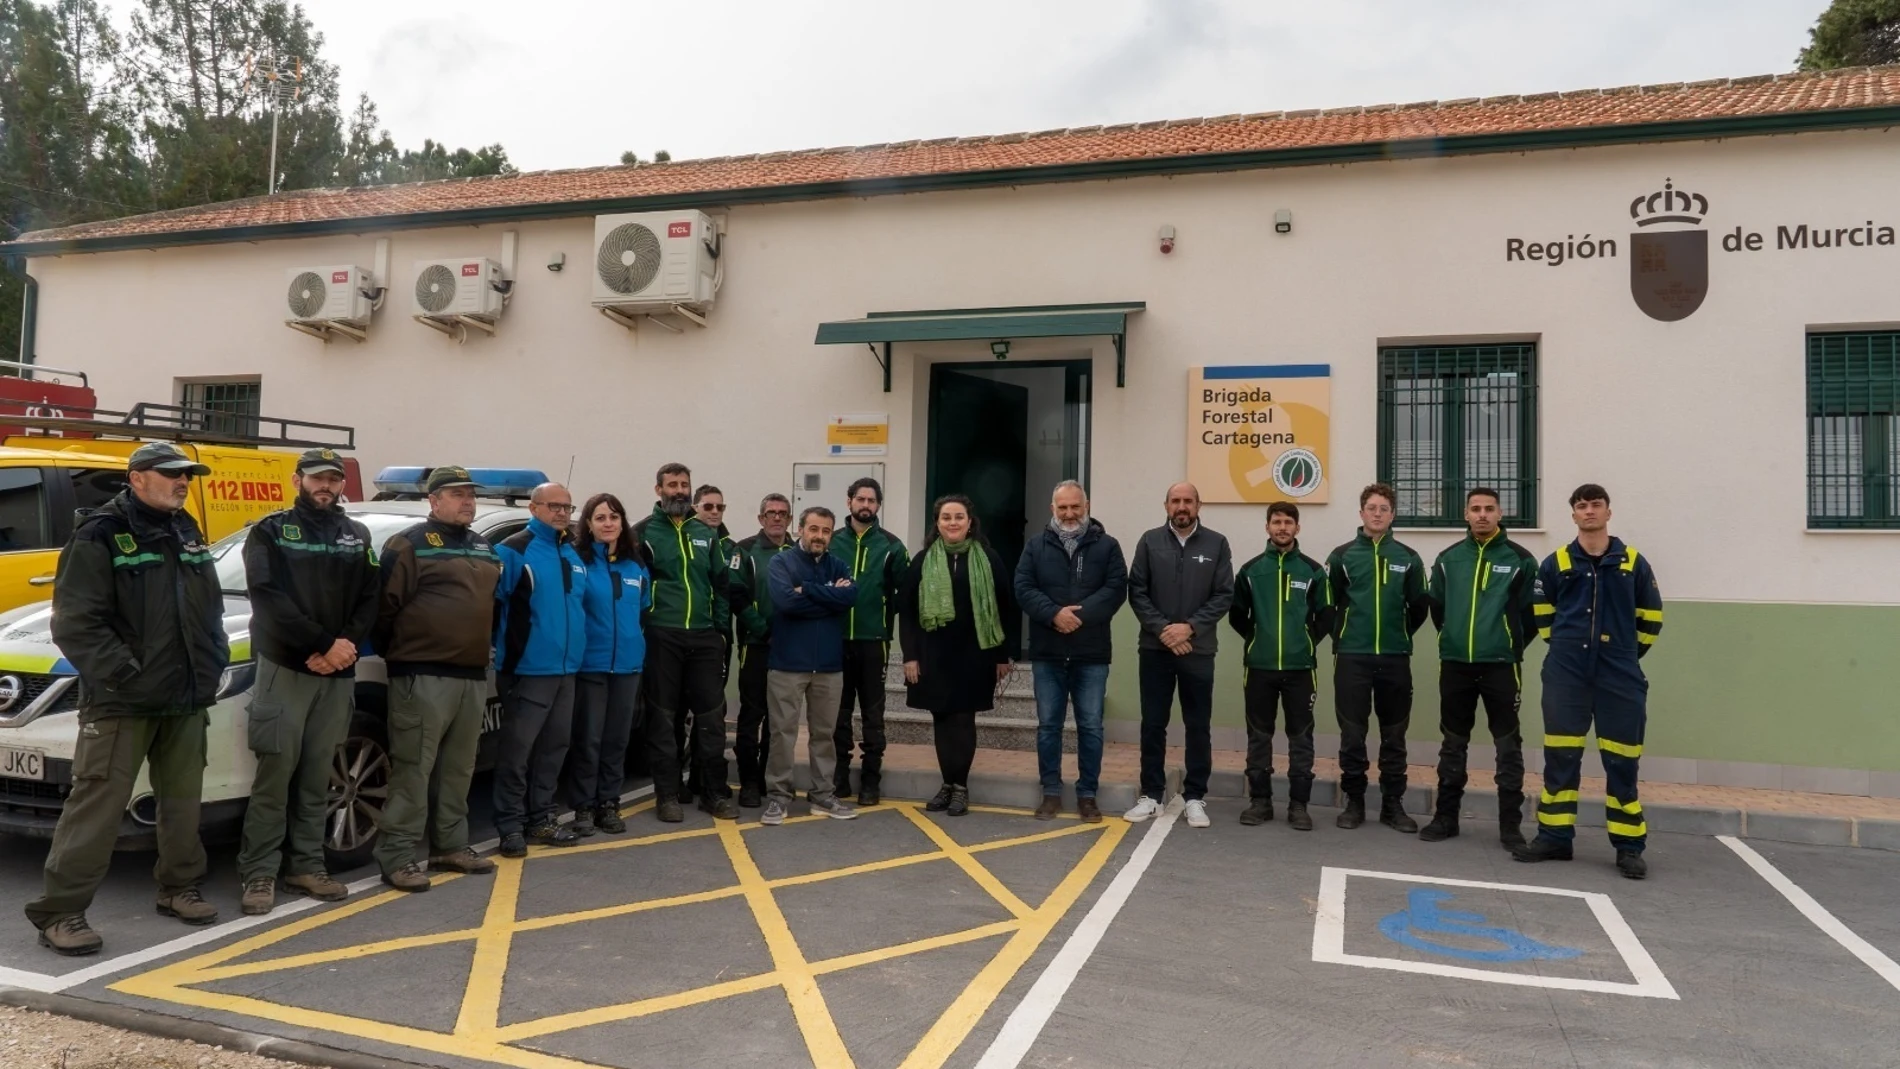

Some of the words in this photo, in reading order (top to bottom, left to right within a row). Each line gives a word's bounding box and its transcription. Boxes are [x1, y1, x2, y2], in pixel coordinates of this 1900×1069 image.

[670, 226, 688, 234] TCL
[1506, 233, 1617, 266] Región
[1722, 226, 1763, 252] de
[1776, 220, 1895, 250] Murcia
[1202, 387, 1272, 407] Brigada
[1202, 408, 1273, 424] Forestal
[1202, 430, 1295, 448] Cartagena
[208, 480, 240, 500] 112
[210, 502, 240, 512] REGIÓN
[244, 503, 254, 513] DE
[4, 751, 39, 775] JKC
